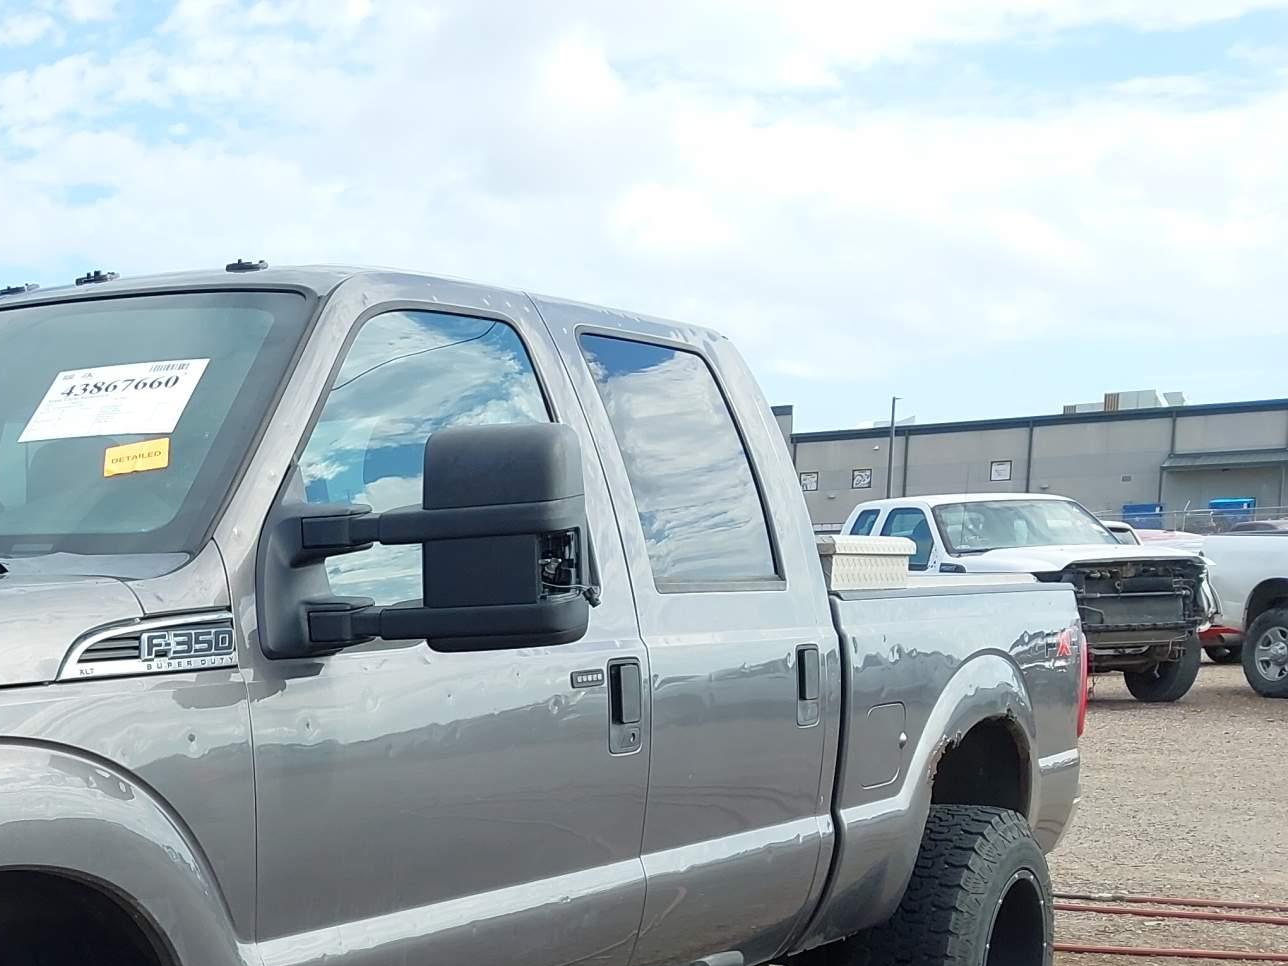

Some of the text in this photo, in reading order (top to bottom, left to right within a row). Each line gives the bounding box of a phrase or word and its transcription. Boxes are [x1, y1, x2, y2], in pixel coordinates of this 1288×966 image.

[61, 375, 180, 397] 43867660
[111, 450, 162, 464] DETAILED
[140, 628, 234, 661] F-350
[147, 656, 234, 671] SUPER DUTY
